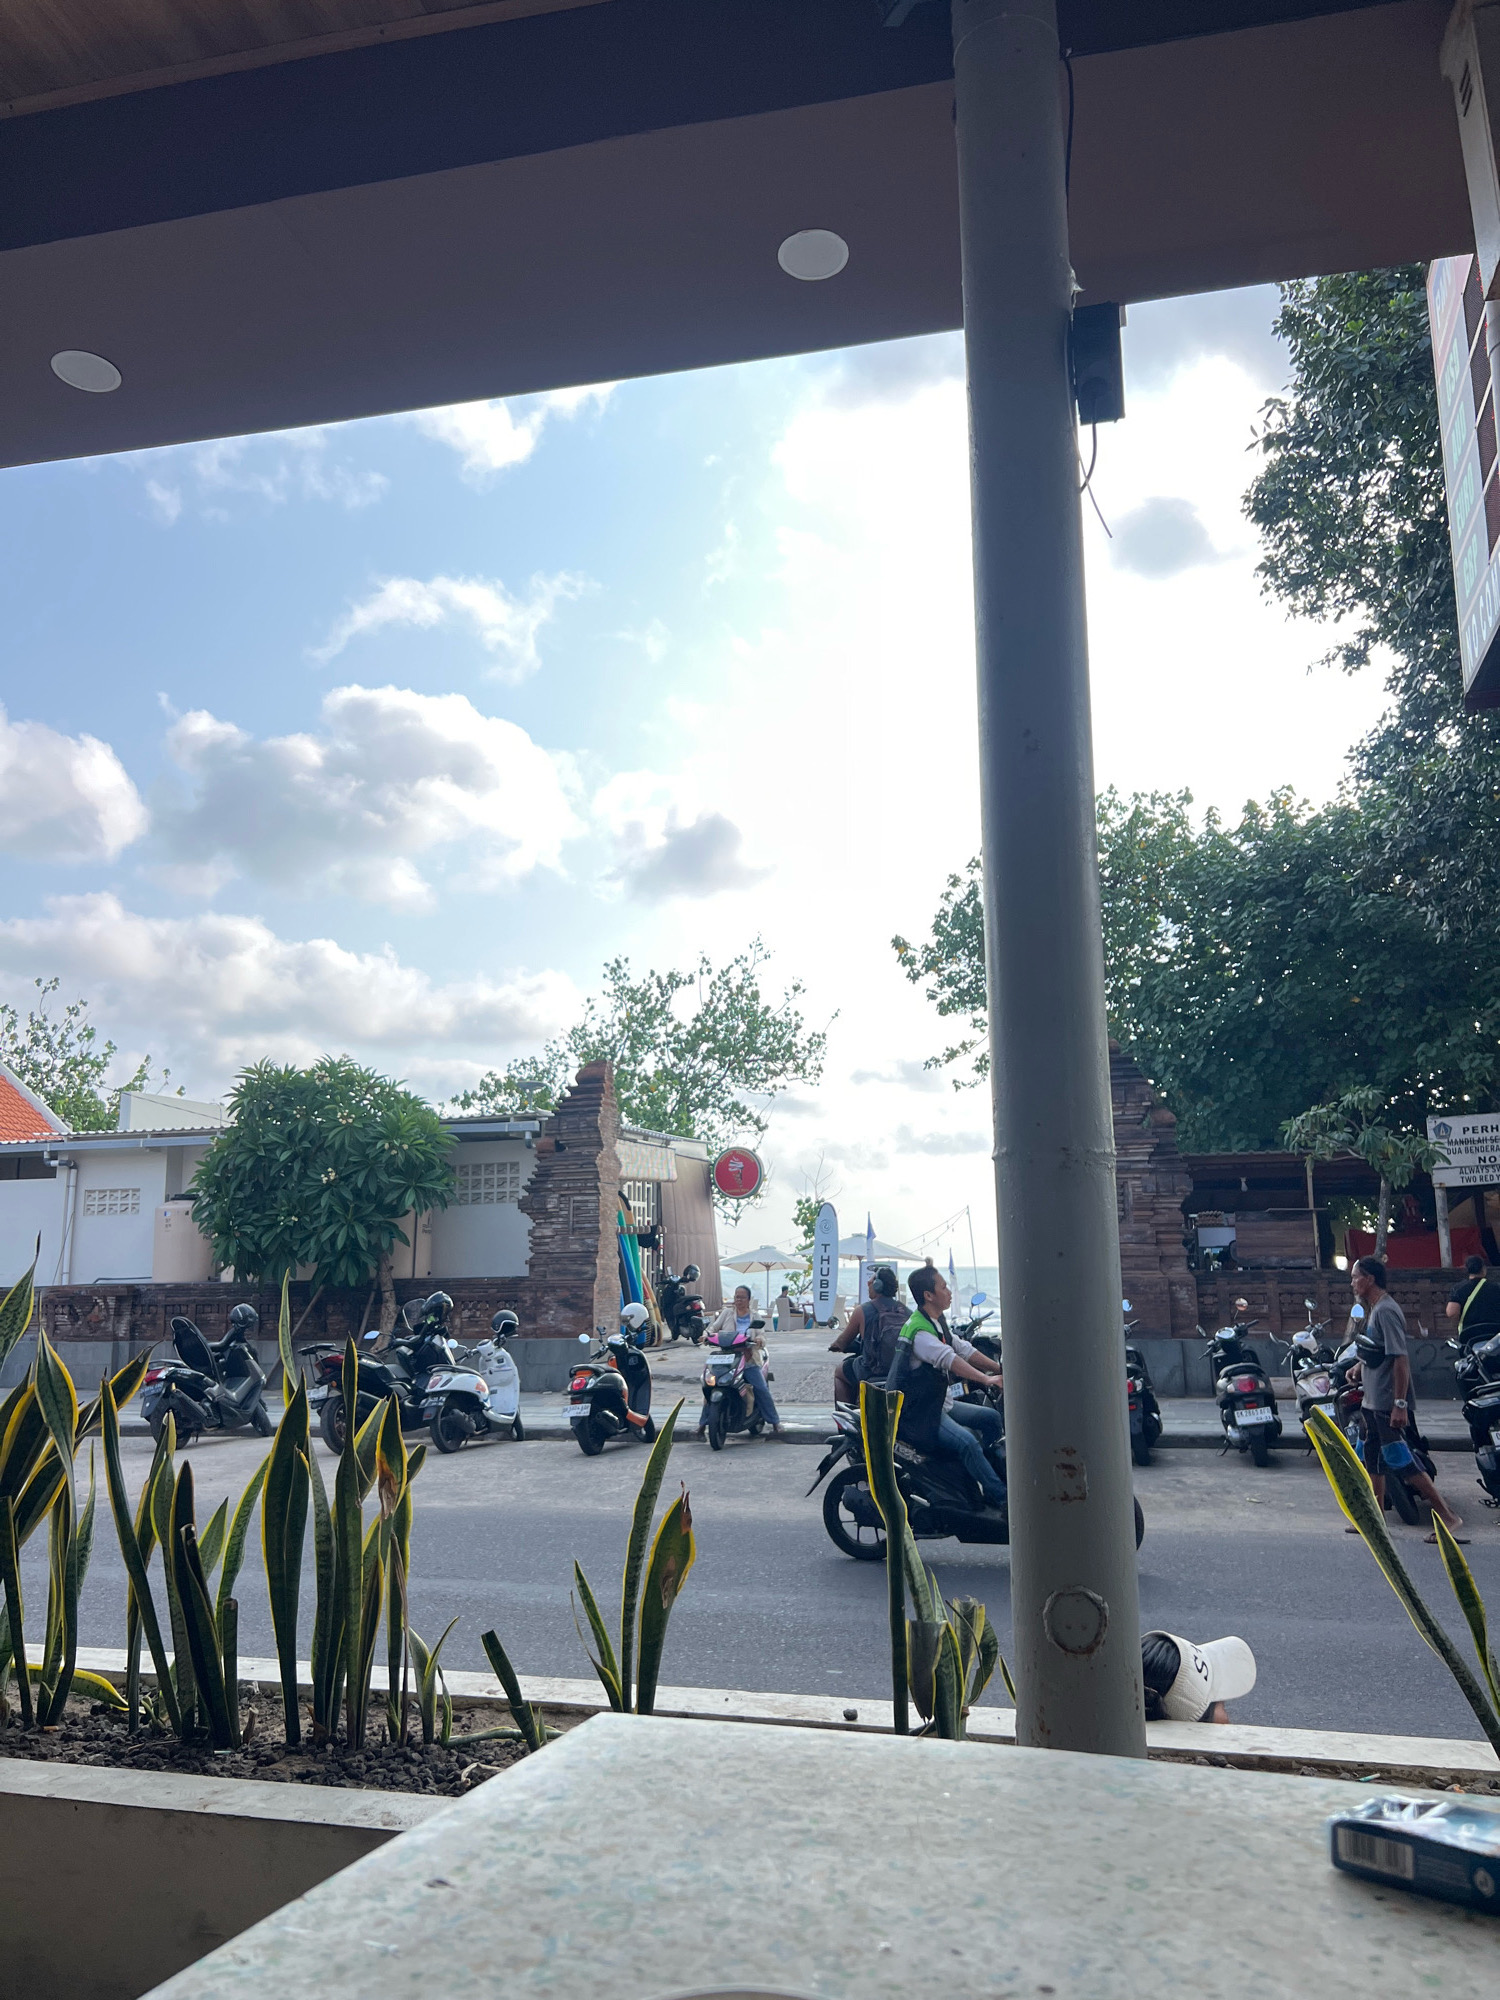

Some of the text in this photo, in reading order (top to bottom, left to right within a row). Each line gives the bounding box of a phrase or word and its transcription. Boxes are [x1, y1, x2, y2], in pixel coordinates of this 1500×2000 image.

[1445, 337, 1460, 407] USD
[1451, 400, 1467, 470] AUD
[1455, 461, 1475, 539] EURO
[1463, 533, 1478, 598] GBP
[1465, 553, 1500, 673] NO COM
[1447, 1136, 1488, 1147] MANDILAH
[1462, 1124, 1499, 1135] PERH
[1446, 1144, 1500, 1155] DUA BENDERA
[1477, 1155, 1498, 1164] NO
[1459, 1165, 1490, 1175] ALWAYS
[1460, 1175, 1477, 1184] TWO
[1479, 1174, 1495, 1183] RED
[819, 1243, 831, 1301] THUBE
